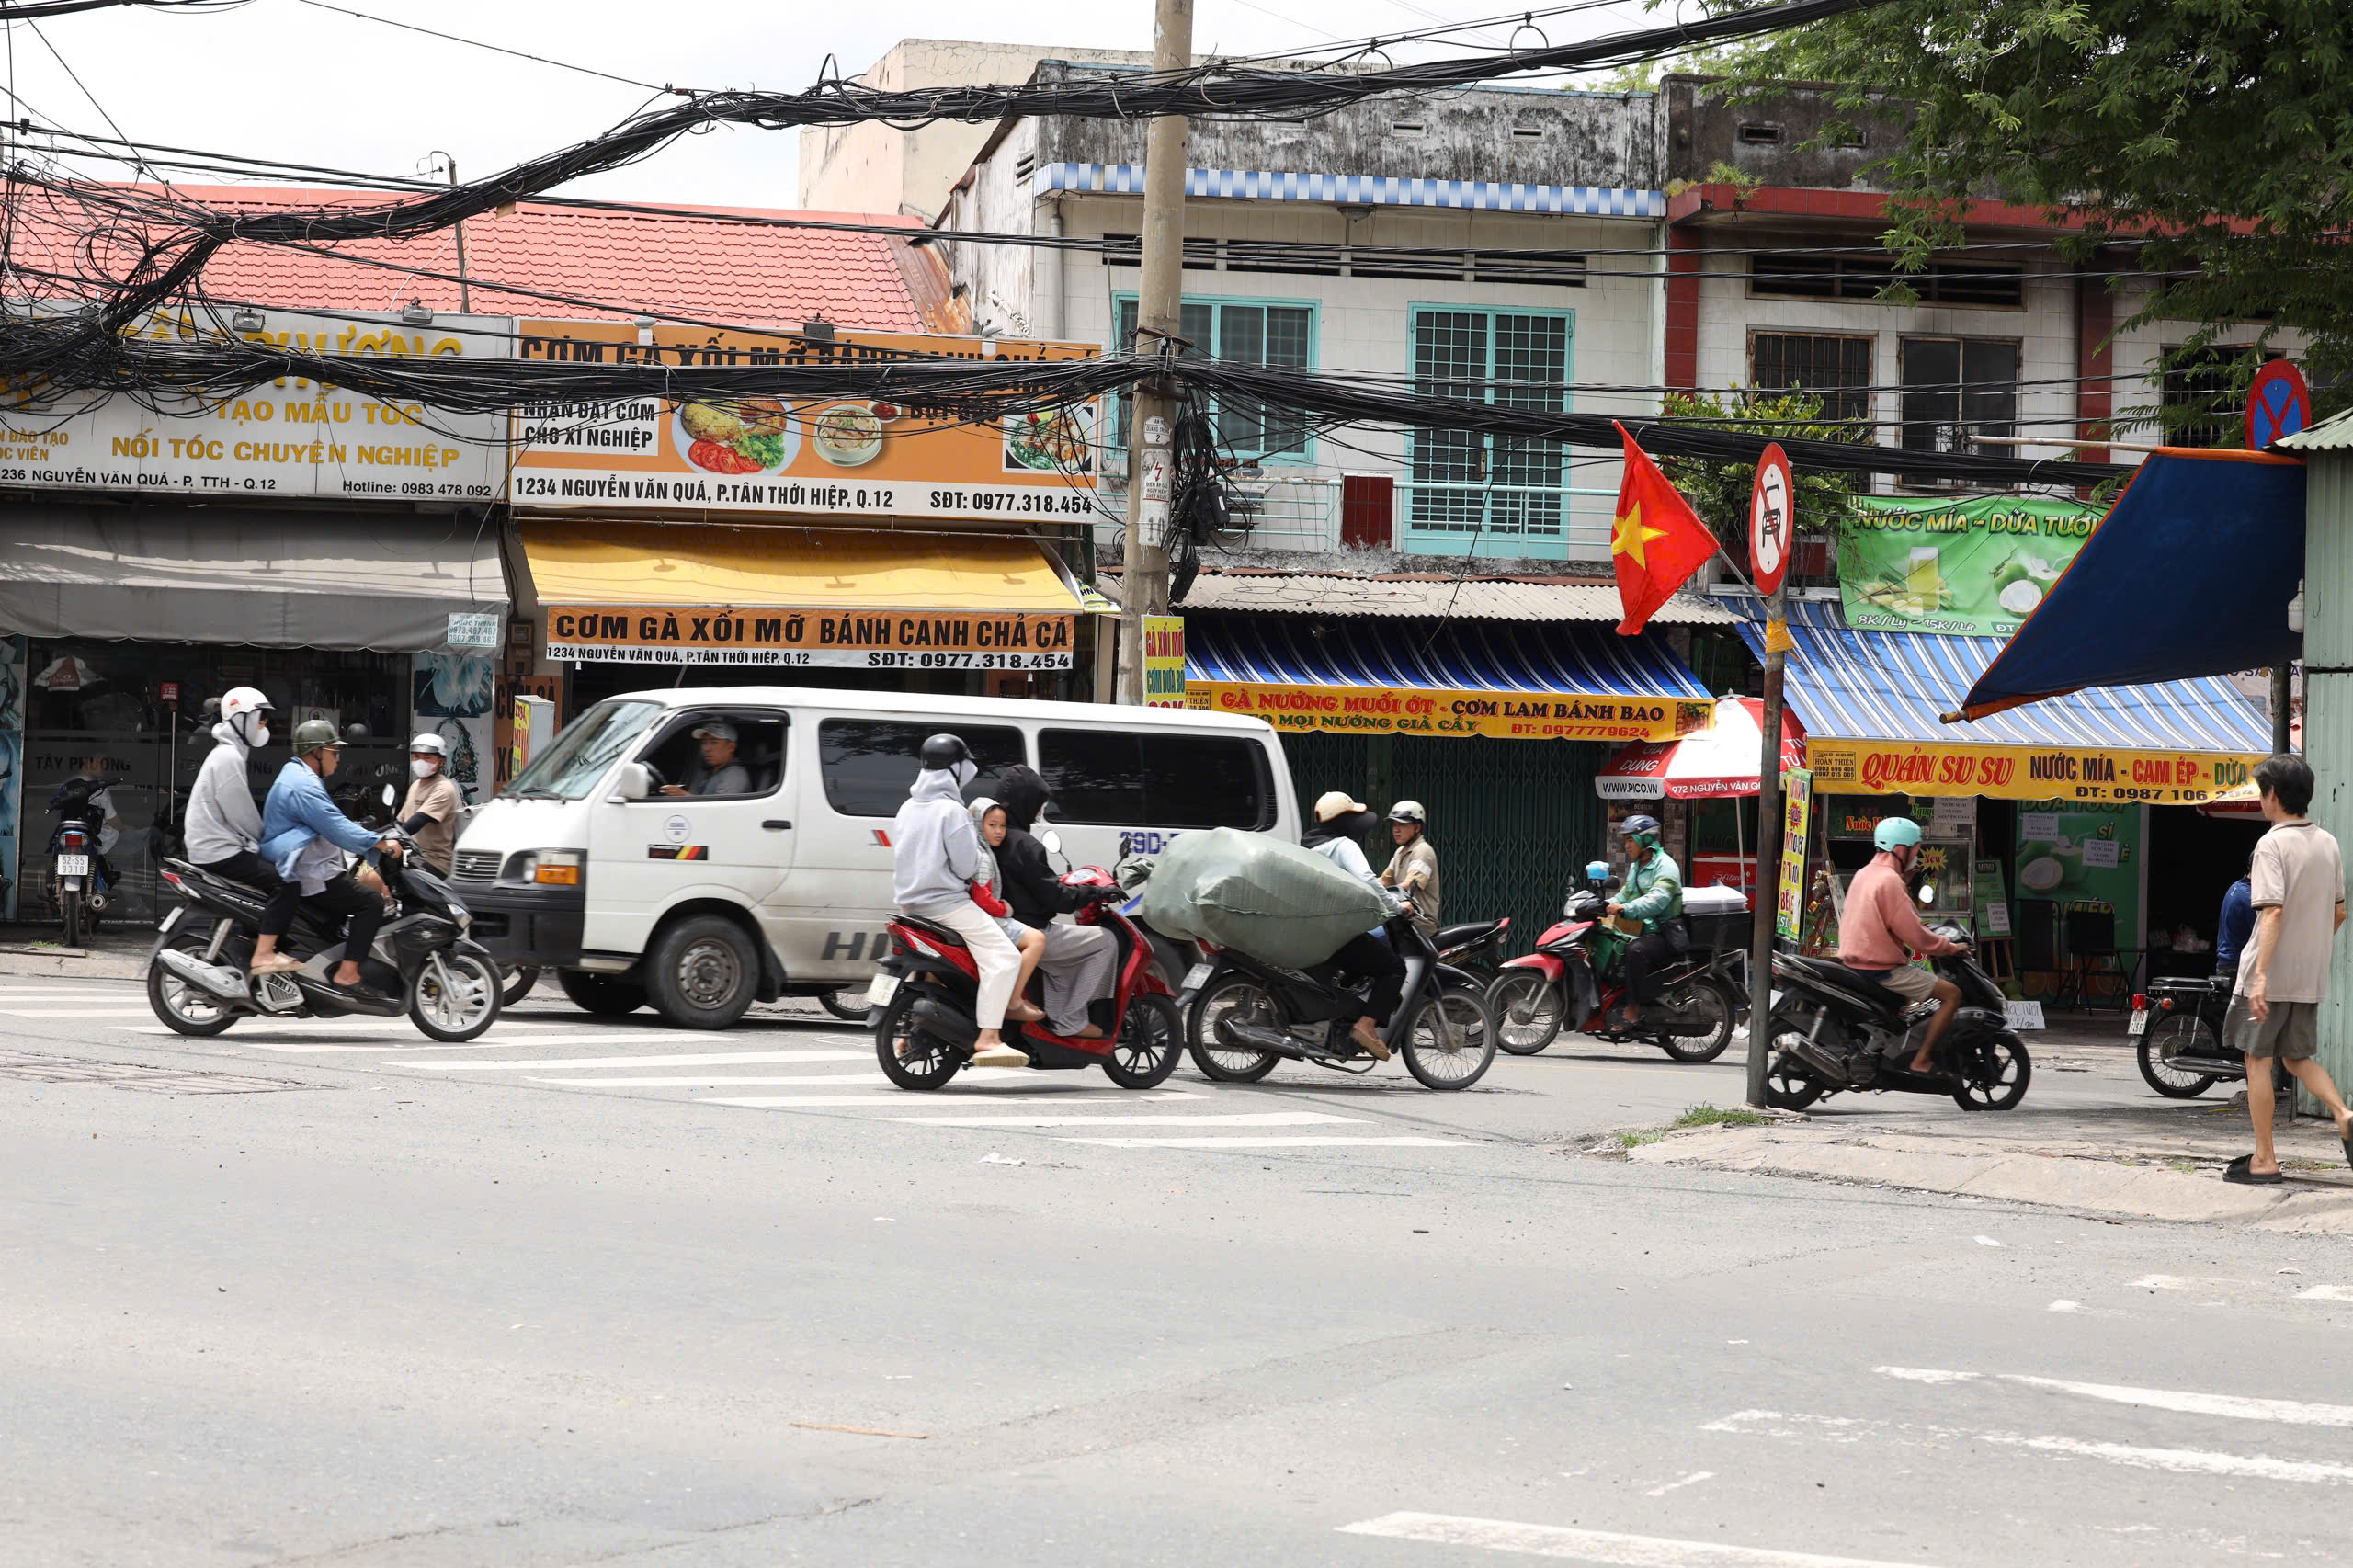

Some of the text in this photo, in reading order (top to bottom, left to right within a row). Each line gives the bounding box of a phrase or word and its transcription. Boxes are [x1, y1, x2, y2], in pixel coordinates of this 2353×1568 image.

[213, 391, 423, 426] TẠO MẪU TÓC
[578, 400, 608, 422] ĐẶT
[616, 402, 655, 422] CƠM
[9, 427, 69, 446] ĐÀO TẠO
[525, 426, 653, 451] CHO XÍ NGHIỆP
[1155, 434, 1161, 442] 2
[17, 446, 49, 461] VIÊN
[112, 428, 460, 472] NỐI TÓC CHUYÊN NGHIỆP
[1, 469, 26, 480] 236
[32, 466, 96, 483] NGUYỄN
[101, 471, 131, 484] VĂN
[137, 472, 168, 486] QUÁ
[183, 476, 193, 487] P.
[202, 476, 229, 488] TTH
[244, 478, 276, 490] Q.12
[343, 481, 491, 496] Hotline: 0983 478 092
[517, 473, 1092, 514] 1234 NGUYỄN VĂN QUÁ, P.TÂN THỚI HIỆP, Q.12 SĐT: 0977.318.454
[1856, 506, 1923, 531] NƯỚC
[1926, 507, 1970, 533] MÍA
[1988, 508, 2038, 535] DỪA
[556, 609, 1067, 648] CƠM GÀ XỐI MỠ BÁNH CANH CHẢ CÁ
[1858, 614, 1879, 625] 8K
[1146, 626, 1156, 657] GÀ
[1158, 621, 1171, 657] XỐI
[547, 646, 1069, 669] 1234 NGUYỄN VĂN QUÁ, P.TÂN THỚI HIỆP, Q.12 SĐT: 0977.318.454
[1221, 691, 1254, 709] GÀ
[1258, 691, 1339, 711] NƯỚNG
[1343, 691, 1401, 713] MUỐI
[1405, 695, 1437, 715] ỚT
[1451, 699, 1499, 719] CƠM
[1504, 701, 1551, 720] LAM
[1554, 700, 1618, 722] BÁNH
[1620, 705, 1666, 722] BAO
[1279, 714, 1315, 730] MỌI
[1321, 713, 1391, 730] NƯỚNG
[1397, 715, 1433, 730] GIẢ
[1438, 716, 1479, 733] CẦY
[1511, 723, 1538, 735] ĐT:
[1542, 723, 1651, 739] 0977779624
[1643, 743, 1665, 755] GIA
[35, 753, 64, 770] TÂY
[1619, 760, 1659, 776] DỤNG
[1814, 757, 1833, 766] HOÀN
[1861, 746, 1940, 790] QUÁN
[1939, 755, 1977, 787] SU
[1978, 756, 2016, 788] SU
[2030, 752, 2080, 783] NƯỚC
[2083, 754, 2116, 783] MÍA
[2132, 759, 2173, 787] CAM
[2176, 756, 2200, 786] ÉP
[2214, 757, 2250, 787] DỪA
[1602, 782, 1658, 795] WWW.PICO.VN
[1672, 786, 1688, 794] 972
[1690, 779, 1728, 792] NGUYỄN
[1730, 780, 1749, 791] VĂN
[2075, 786, 2107, 798] ĐT:
[2113, 788, 2163, 800] 0987
[2171, 789, 2209, 801] 106
[62, 856, 85, 865] 52-S5
[1924, 854, 1942, 863] New
[62, 865, 85, 873] 9318
